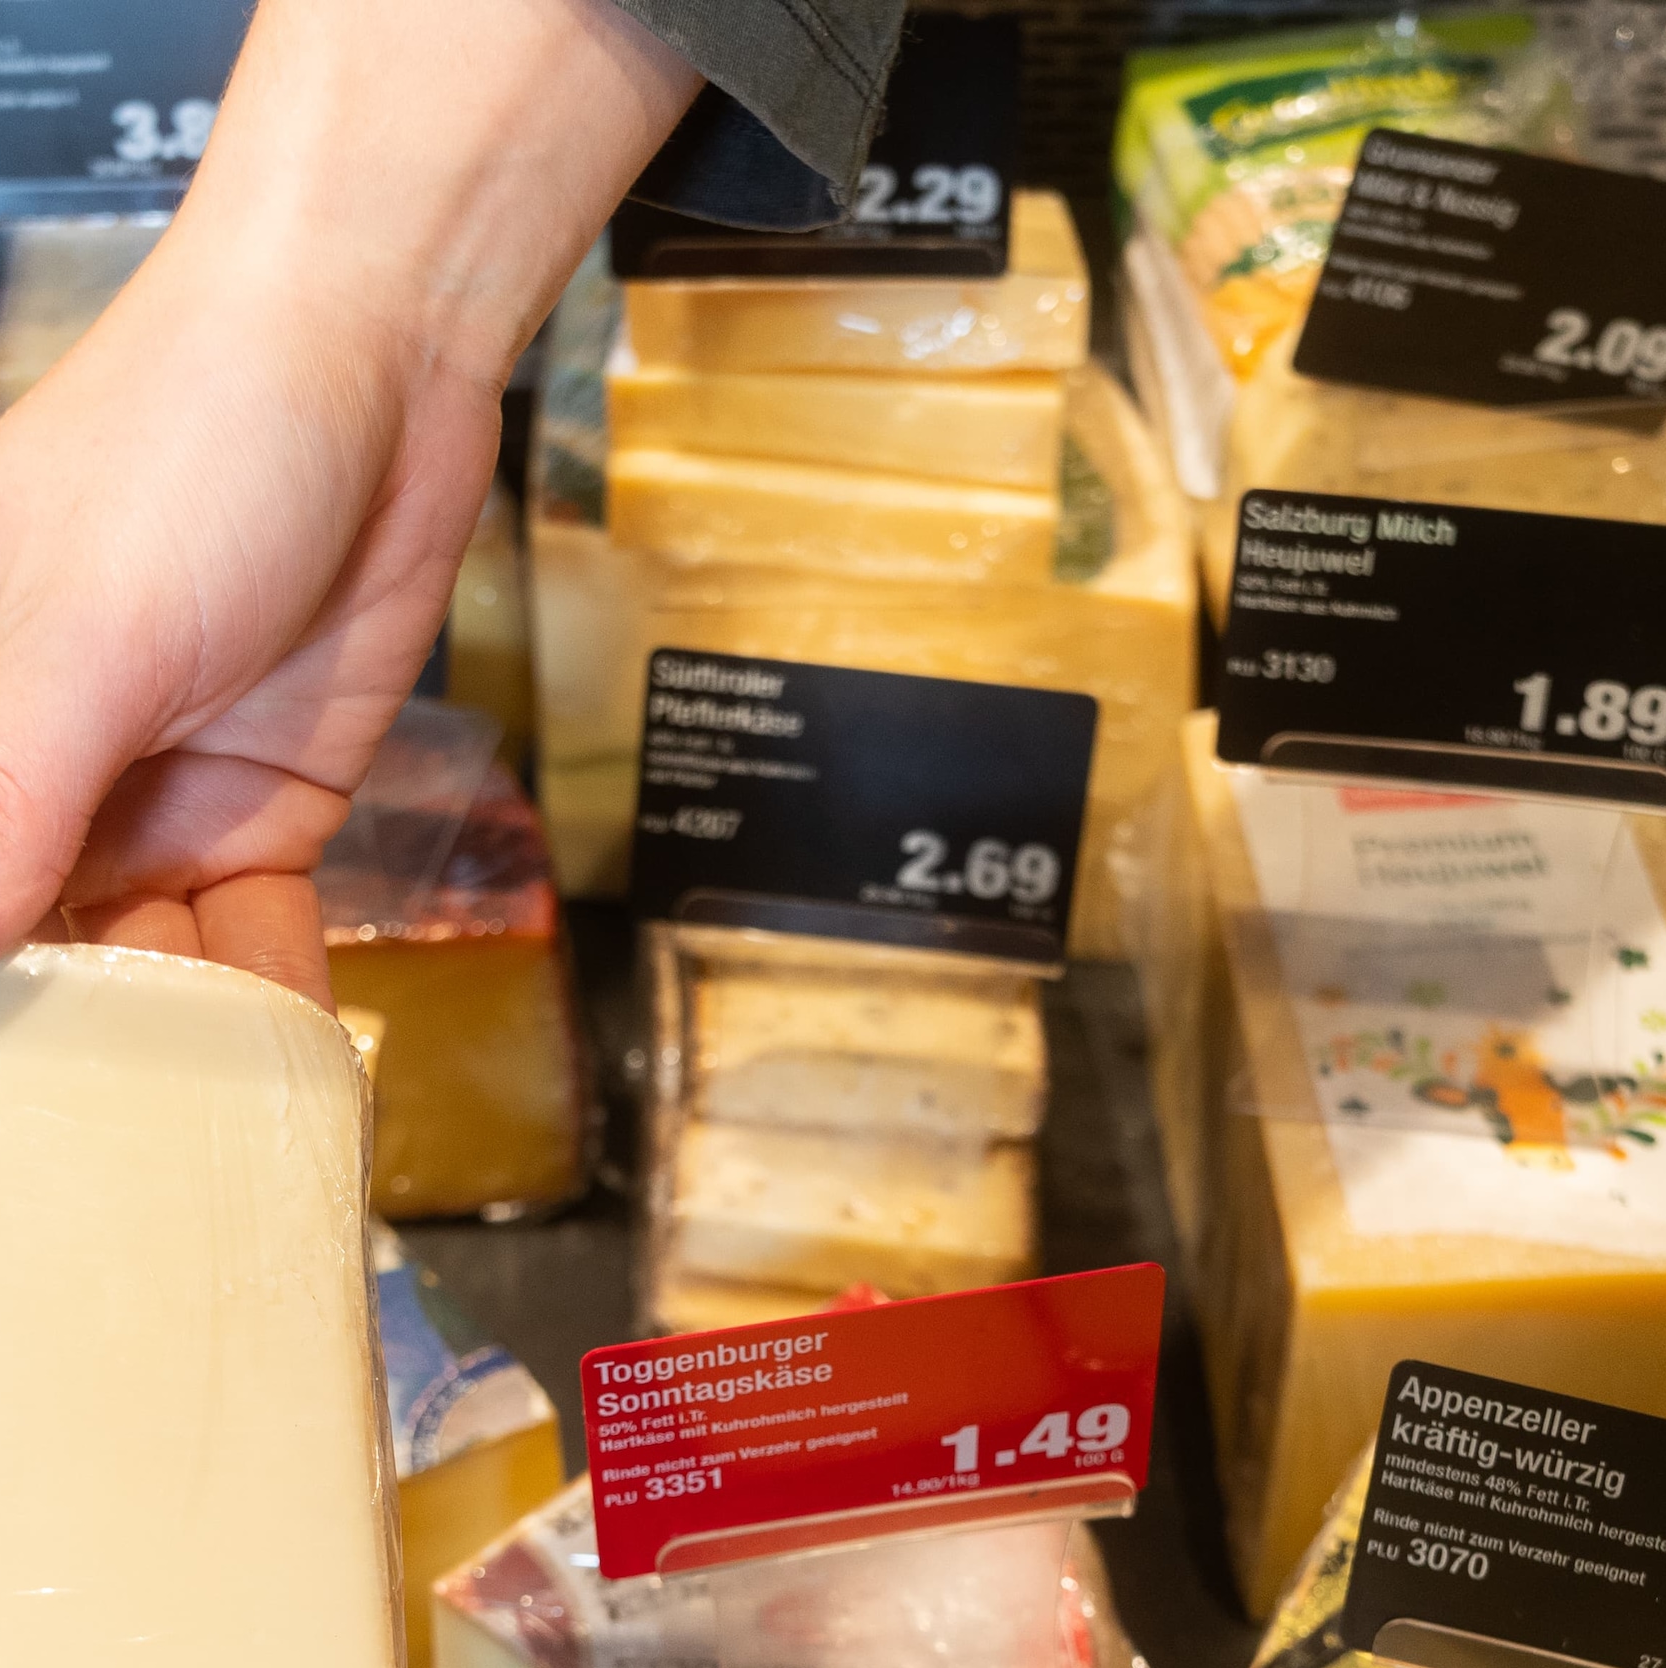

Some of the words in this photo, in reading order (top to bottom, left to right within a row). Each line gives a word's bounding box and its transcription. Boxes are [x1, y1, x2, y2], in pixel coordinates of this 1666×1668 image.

[1243, 500, 1370, 544] Salzburg
[1378, 511, 1458, 546] Milch
[895, 828, 1060, 902] 2.69
[593, 1331, 828, 1386] Toggenburger
[597, 1362, 832, 1417] Sonntagskäse
[1397, 1374, 1597, 1445] Appenzeller
[599, 1420, 637, 1438] 50%
[641, 1413, 676, 1432] Fett
[599, 1429, 676, 1453] Hartkäse
[679, 1423, 707, 1440] mit
[711, 1406, 816, 1435] Kuhrohmilch
[942, 1402, 1131, 1473] 1.49
[654, 1456, 697, 1476] nicht
[700, 1450, 736, 1466] zum
[739, 1439, 794, 1461] Verzehr
[1385, 1452, 1480, 1487] mindestens
[1484, 1475, 1521, 1496] 48%
[1526, 1483, 1559, 1507] Fett
[1391, 1413, 1625, 1498] kräftig-würzig
[644, 1467, 724, 1502] 3351
[1381, 1469, 1454, 1500] Hartkäse
[1458, 1488, 1486, 1508] mit
[1489, 1495, 1594, 1535] Kuhrohmilch
[1367, 1540, 1400, 1561] PLU
[1407, 1538, 1489, 1581] 3070
[1373, 1508, 1420, 1533] Rinde
[1424, 1521, 1465, 1544] nicht
[1468, 1531, 1504, 1552] zum
[1508, 1539, 1570, 1568] Verzehr
[1574, 1553, 1647, 1587] geeignet
